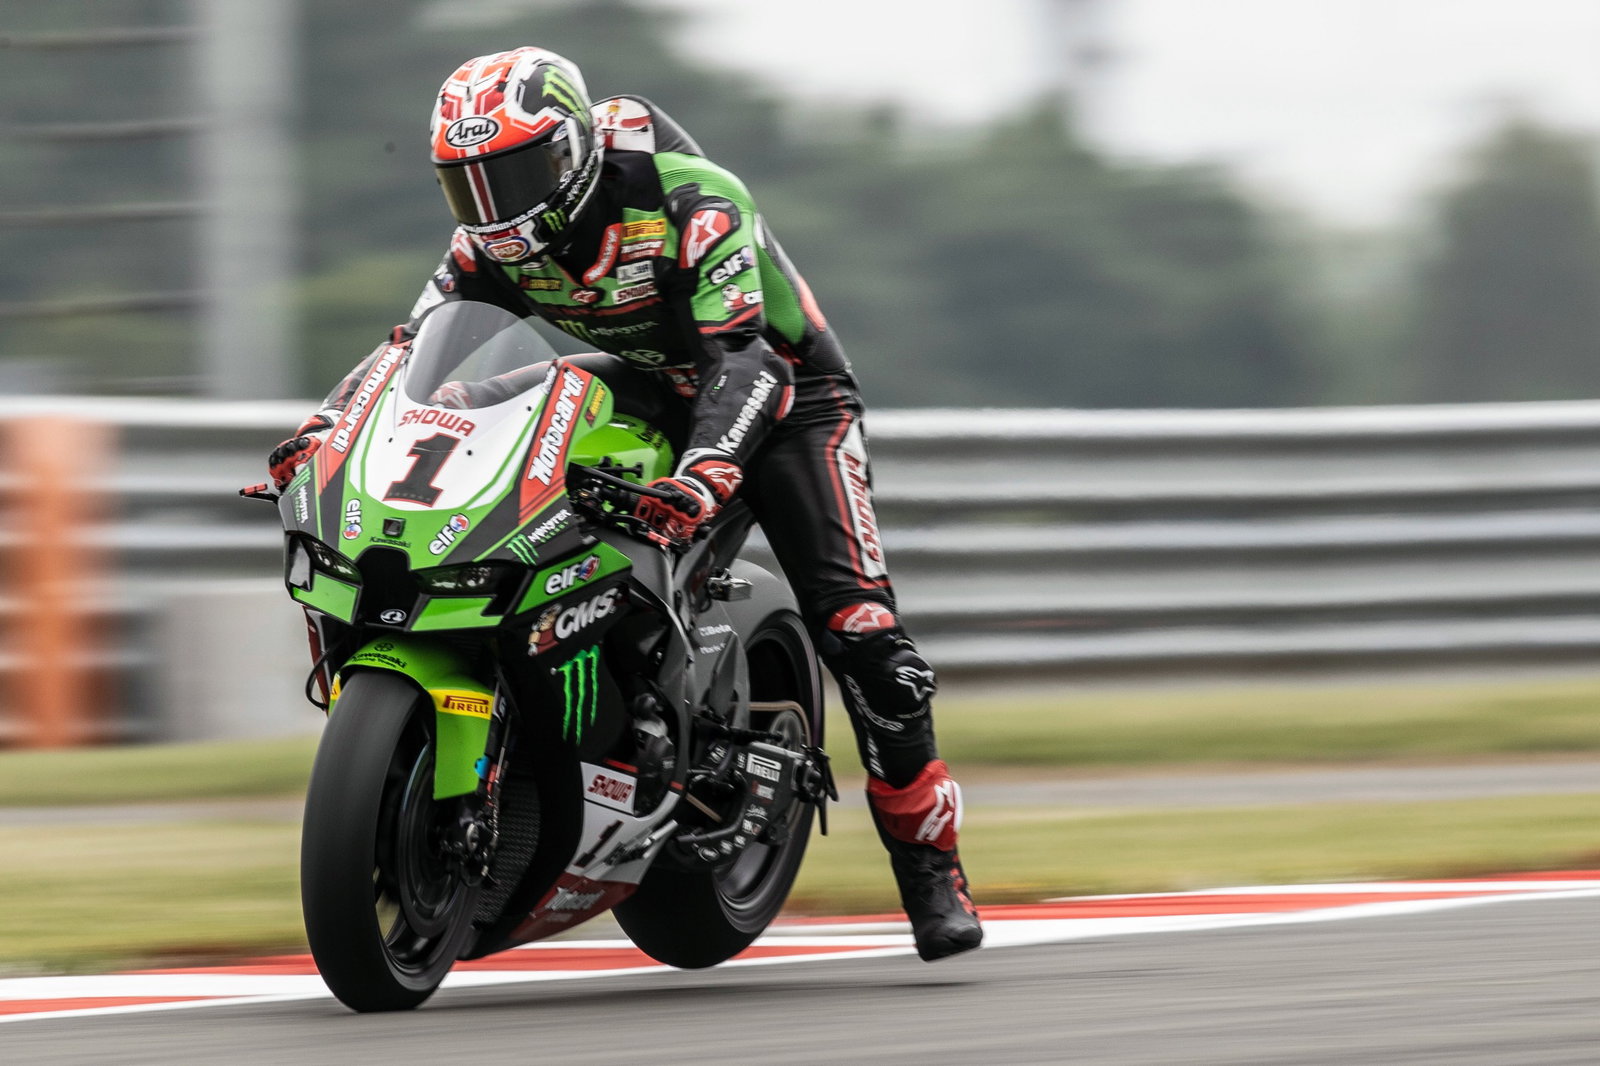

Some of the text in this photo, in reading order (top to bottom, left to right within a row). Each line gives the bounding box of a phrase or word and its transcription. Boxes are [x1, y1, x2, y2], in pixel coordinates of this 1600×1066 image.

[447, 120, 492, 143] Arai
[711, 254, 743, 284] elf
[398, 409, 476, 437] SHOWA
[716, 370, 778, 454] Kawasaki
[382, 432, 462, 508] 1
[345, 499, 361, 526] elf
[429, 525, 456, 555] elf
[545, 565, 579, 594] elf
[555, 587, 618, 639] CMS
[443, 695, 489, 714] PIRELLI
[746, 753, 782, 782] PIRELLI
